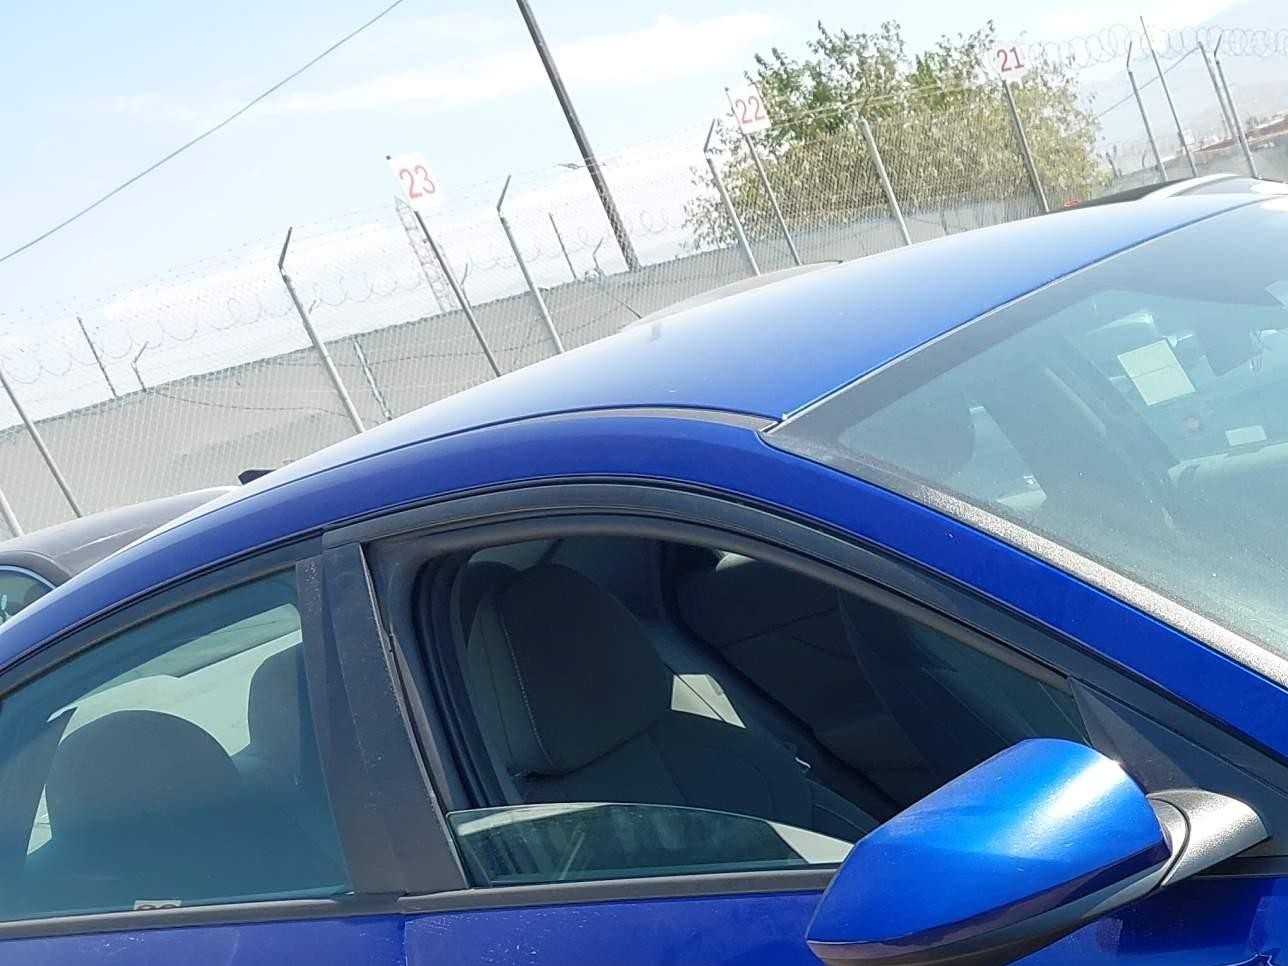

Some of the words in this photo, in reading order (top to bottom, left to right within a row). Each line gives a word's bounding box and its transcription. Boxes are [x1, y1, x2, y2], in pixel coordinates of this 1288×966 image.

[996, 46, 1025, 72] 21
[735, 95, 766, 124] 22
[398, 164, 436, 199] 23
